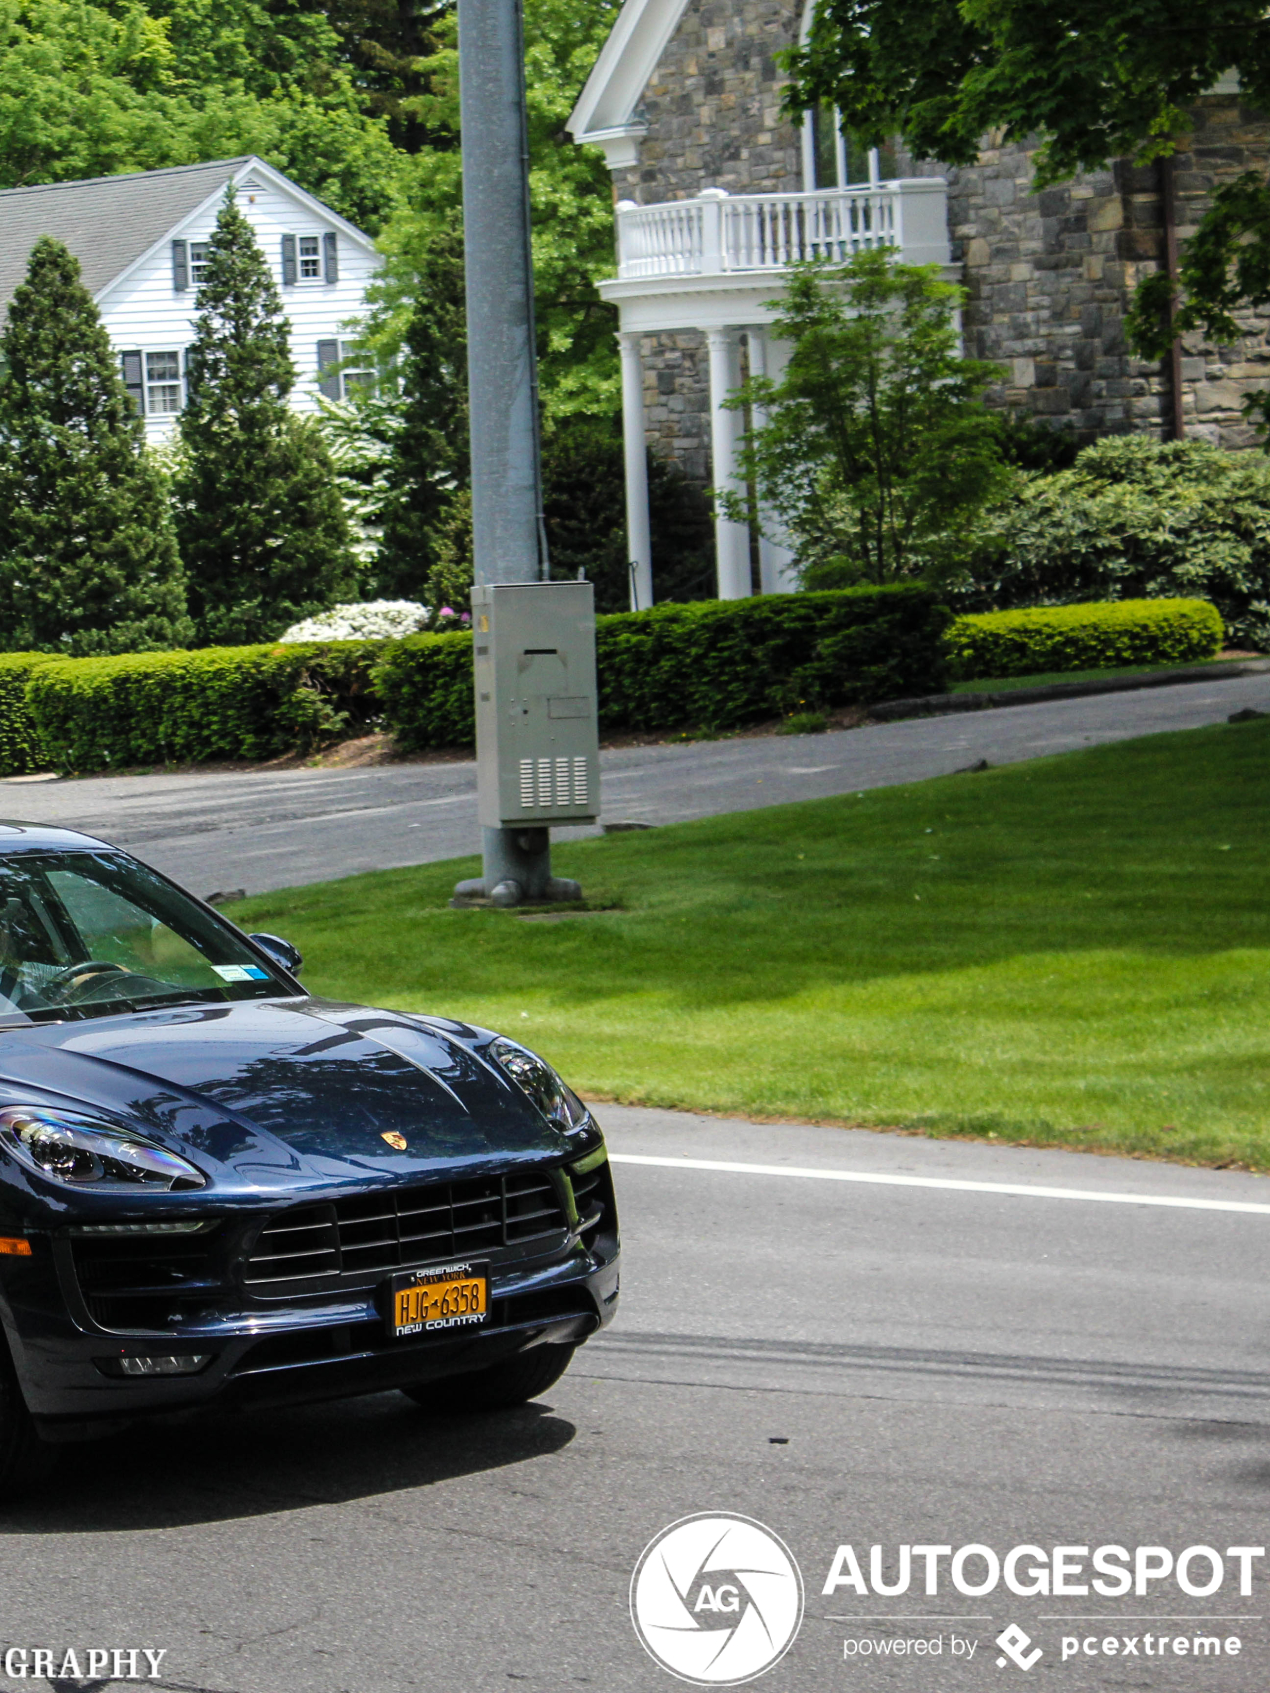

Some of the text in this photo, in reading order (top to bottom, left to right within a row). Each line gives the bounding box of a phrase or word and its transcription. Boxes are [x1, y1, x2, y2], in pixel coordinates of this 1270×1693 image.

[416, 1263, 469, 1278] GREENWICH
[416, 1271, 466, 1287] NEW YORK
[396, 1312, 487, 1337] NEW COUNTRY
